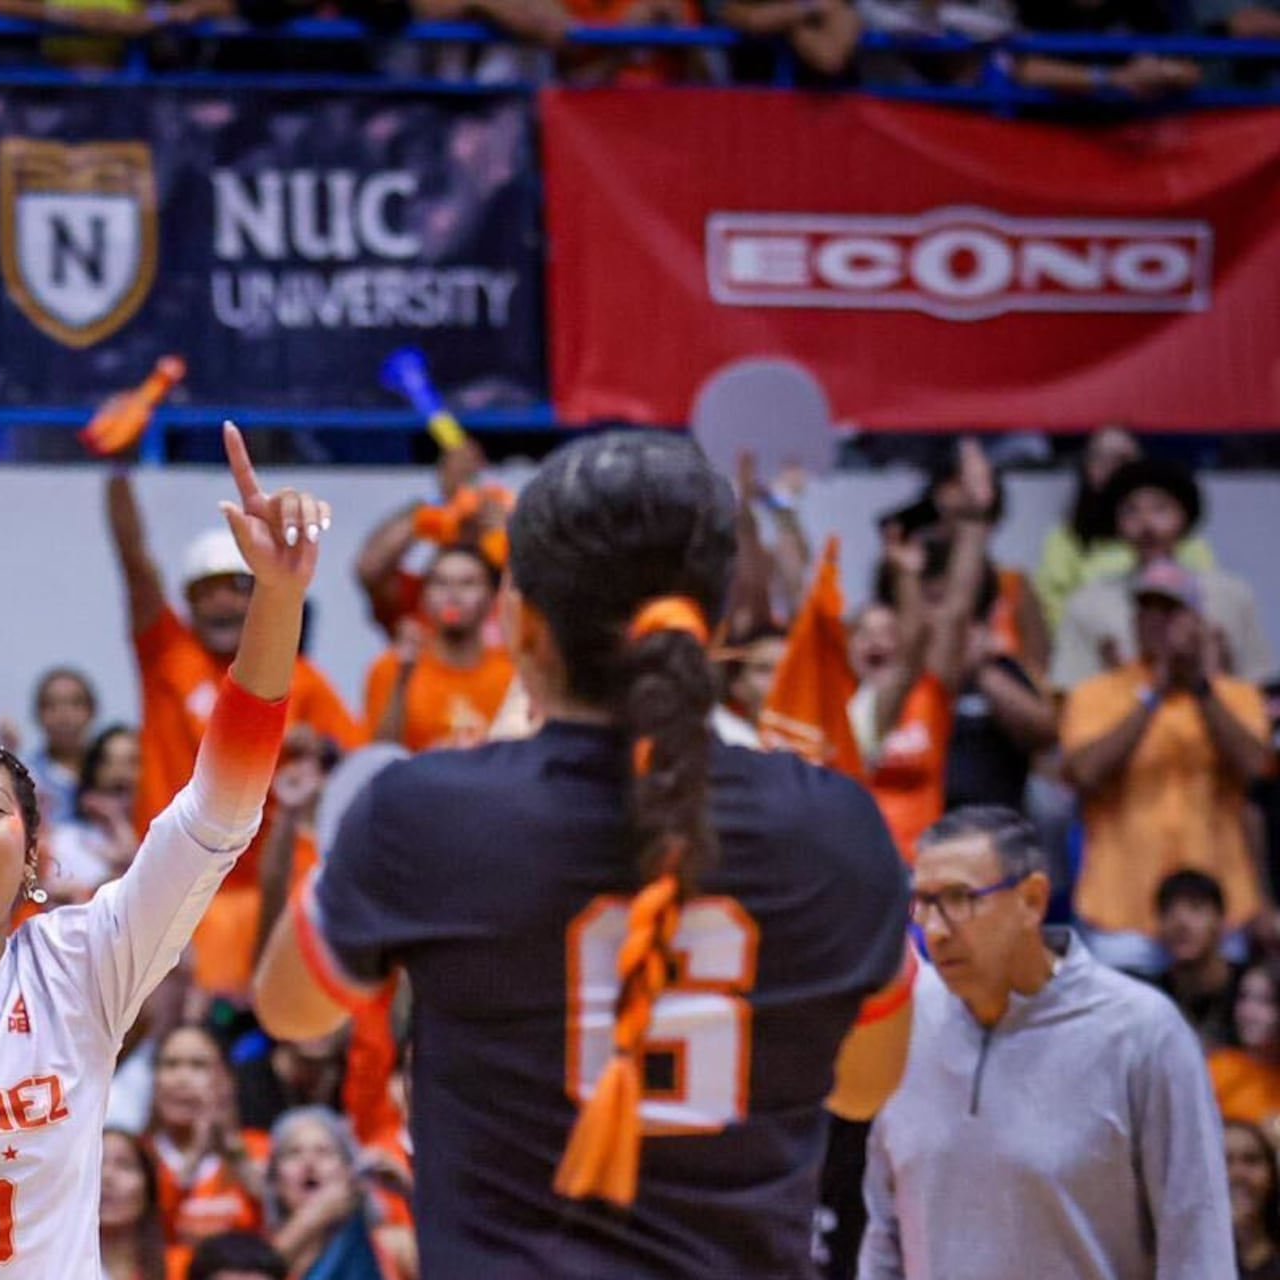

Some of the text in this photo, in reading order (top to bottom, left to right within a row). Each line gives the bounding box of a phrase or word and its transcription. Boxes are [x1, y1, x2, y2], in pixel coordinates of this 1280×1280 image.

[49, 213, 106, 288] N
[211, 168, 421, 260] NUC
[210, 269, 516, 330] UNIVERSITY
[727, 227, 1192, 298] ECONO
[565, 895, 759, 1136] 6
